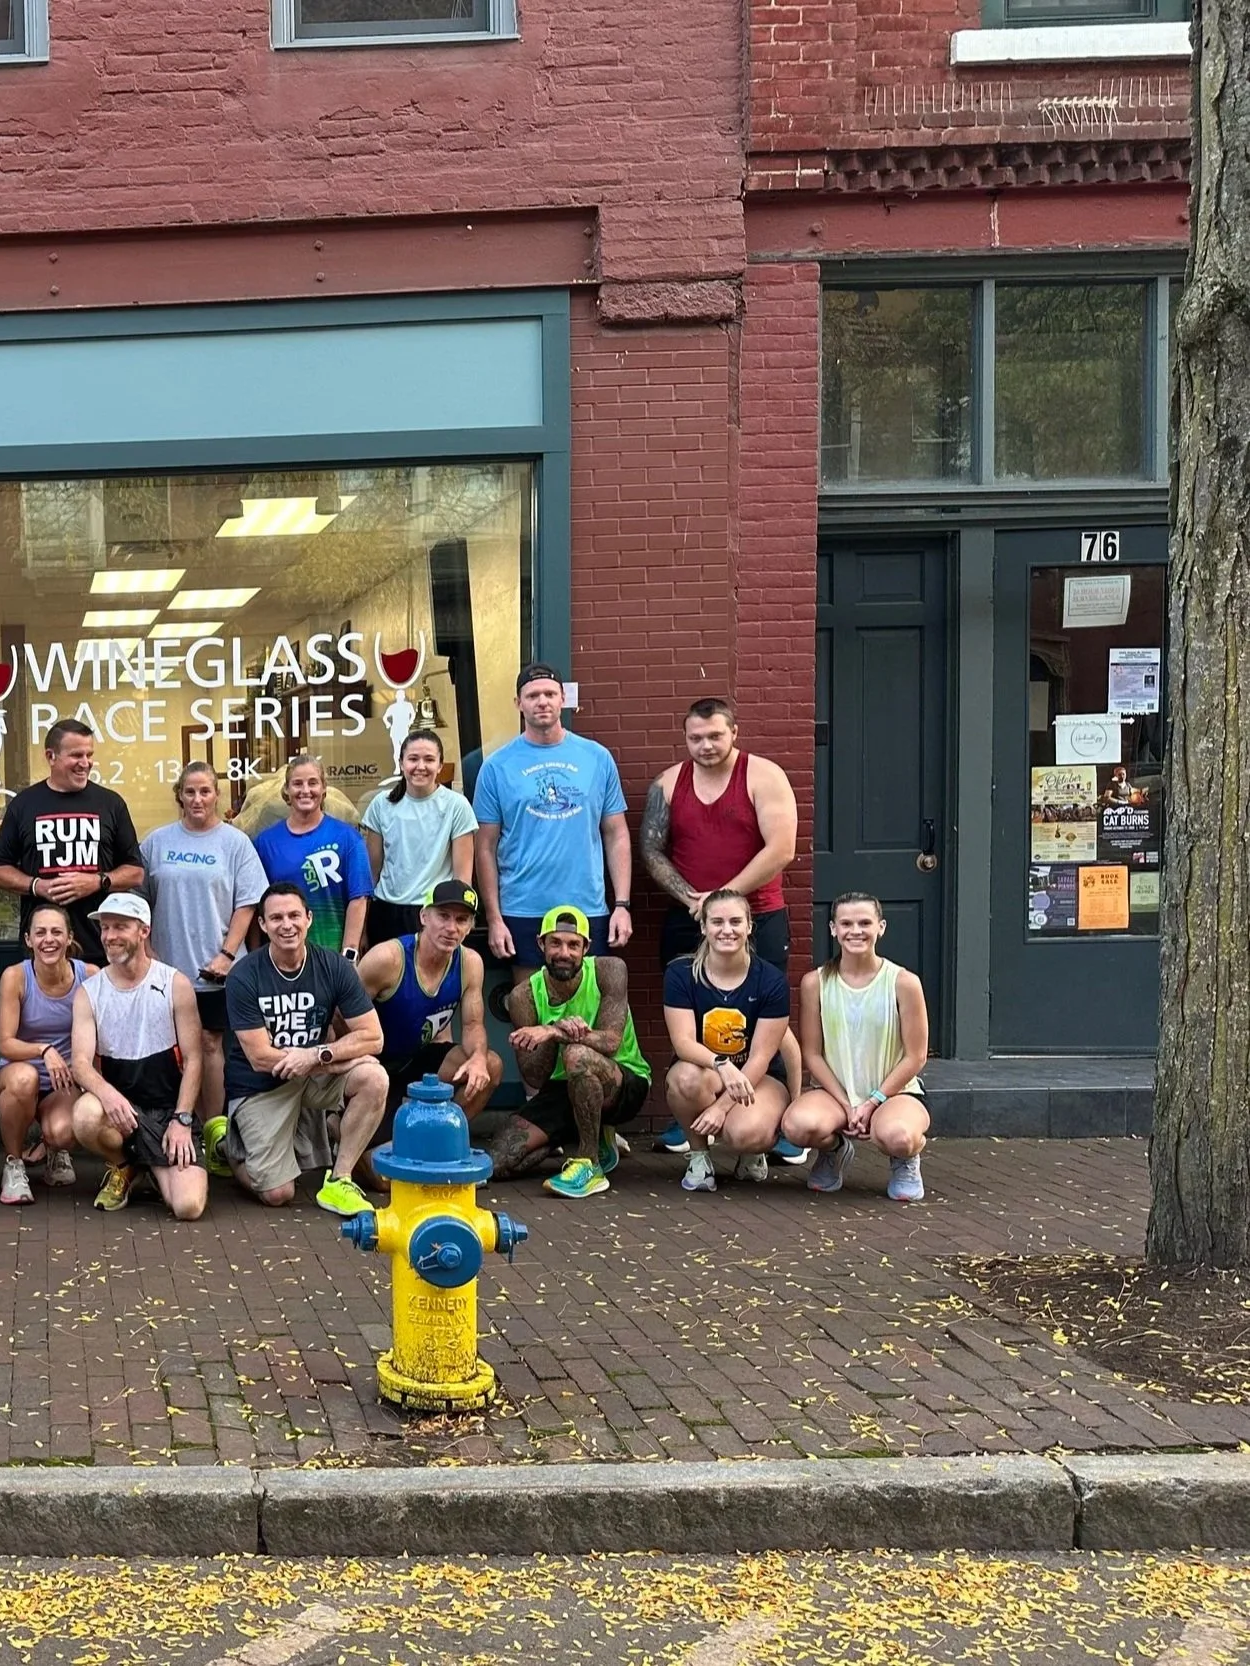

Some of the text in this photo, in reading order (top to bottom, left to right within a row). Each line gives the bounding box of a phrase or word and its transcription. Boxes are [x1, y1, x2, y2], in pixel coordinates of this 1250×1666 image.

[1084, 532, 1117, 561] 76
[24, 632, 366, 692] WINEGLASS
[31, 693, 366, 745] RACE SERIES
[227, 758, 262, 780] 8K
[327, 763, 378, 777] RACING
[35, 818, 101, 843] RUN
[1103, 815, 1149, 826] CAT BURNS
[37, 841, 99, 868] TJM
[167, 850, 216, 865] RACING
[301, 860, 320, 892] USA
[258, 992, 315, 1015] FIND
[264, 1012, 307, 1033] THE
[269, 1027, 321, 1047] OOD
[408, 1294, 468, 1311] KENNEDY
